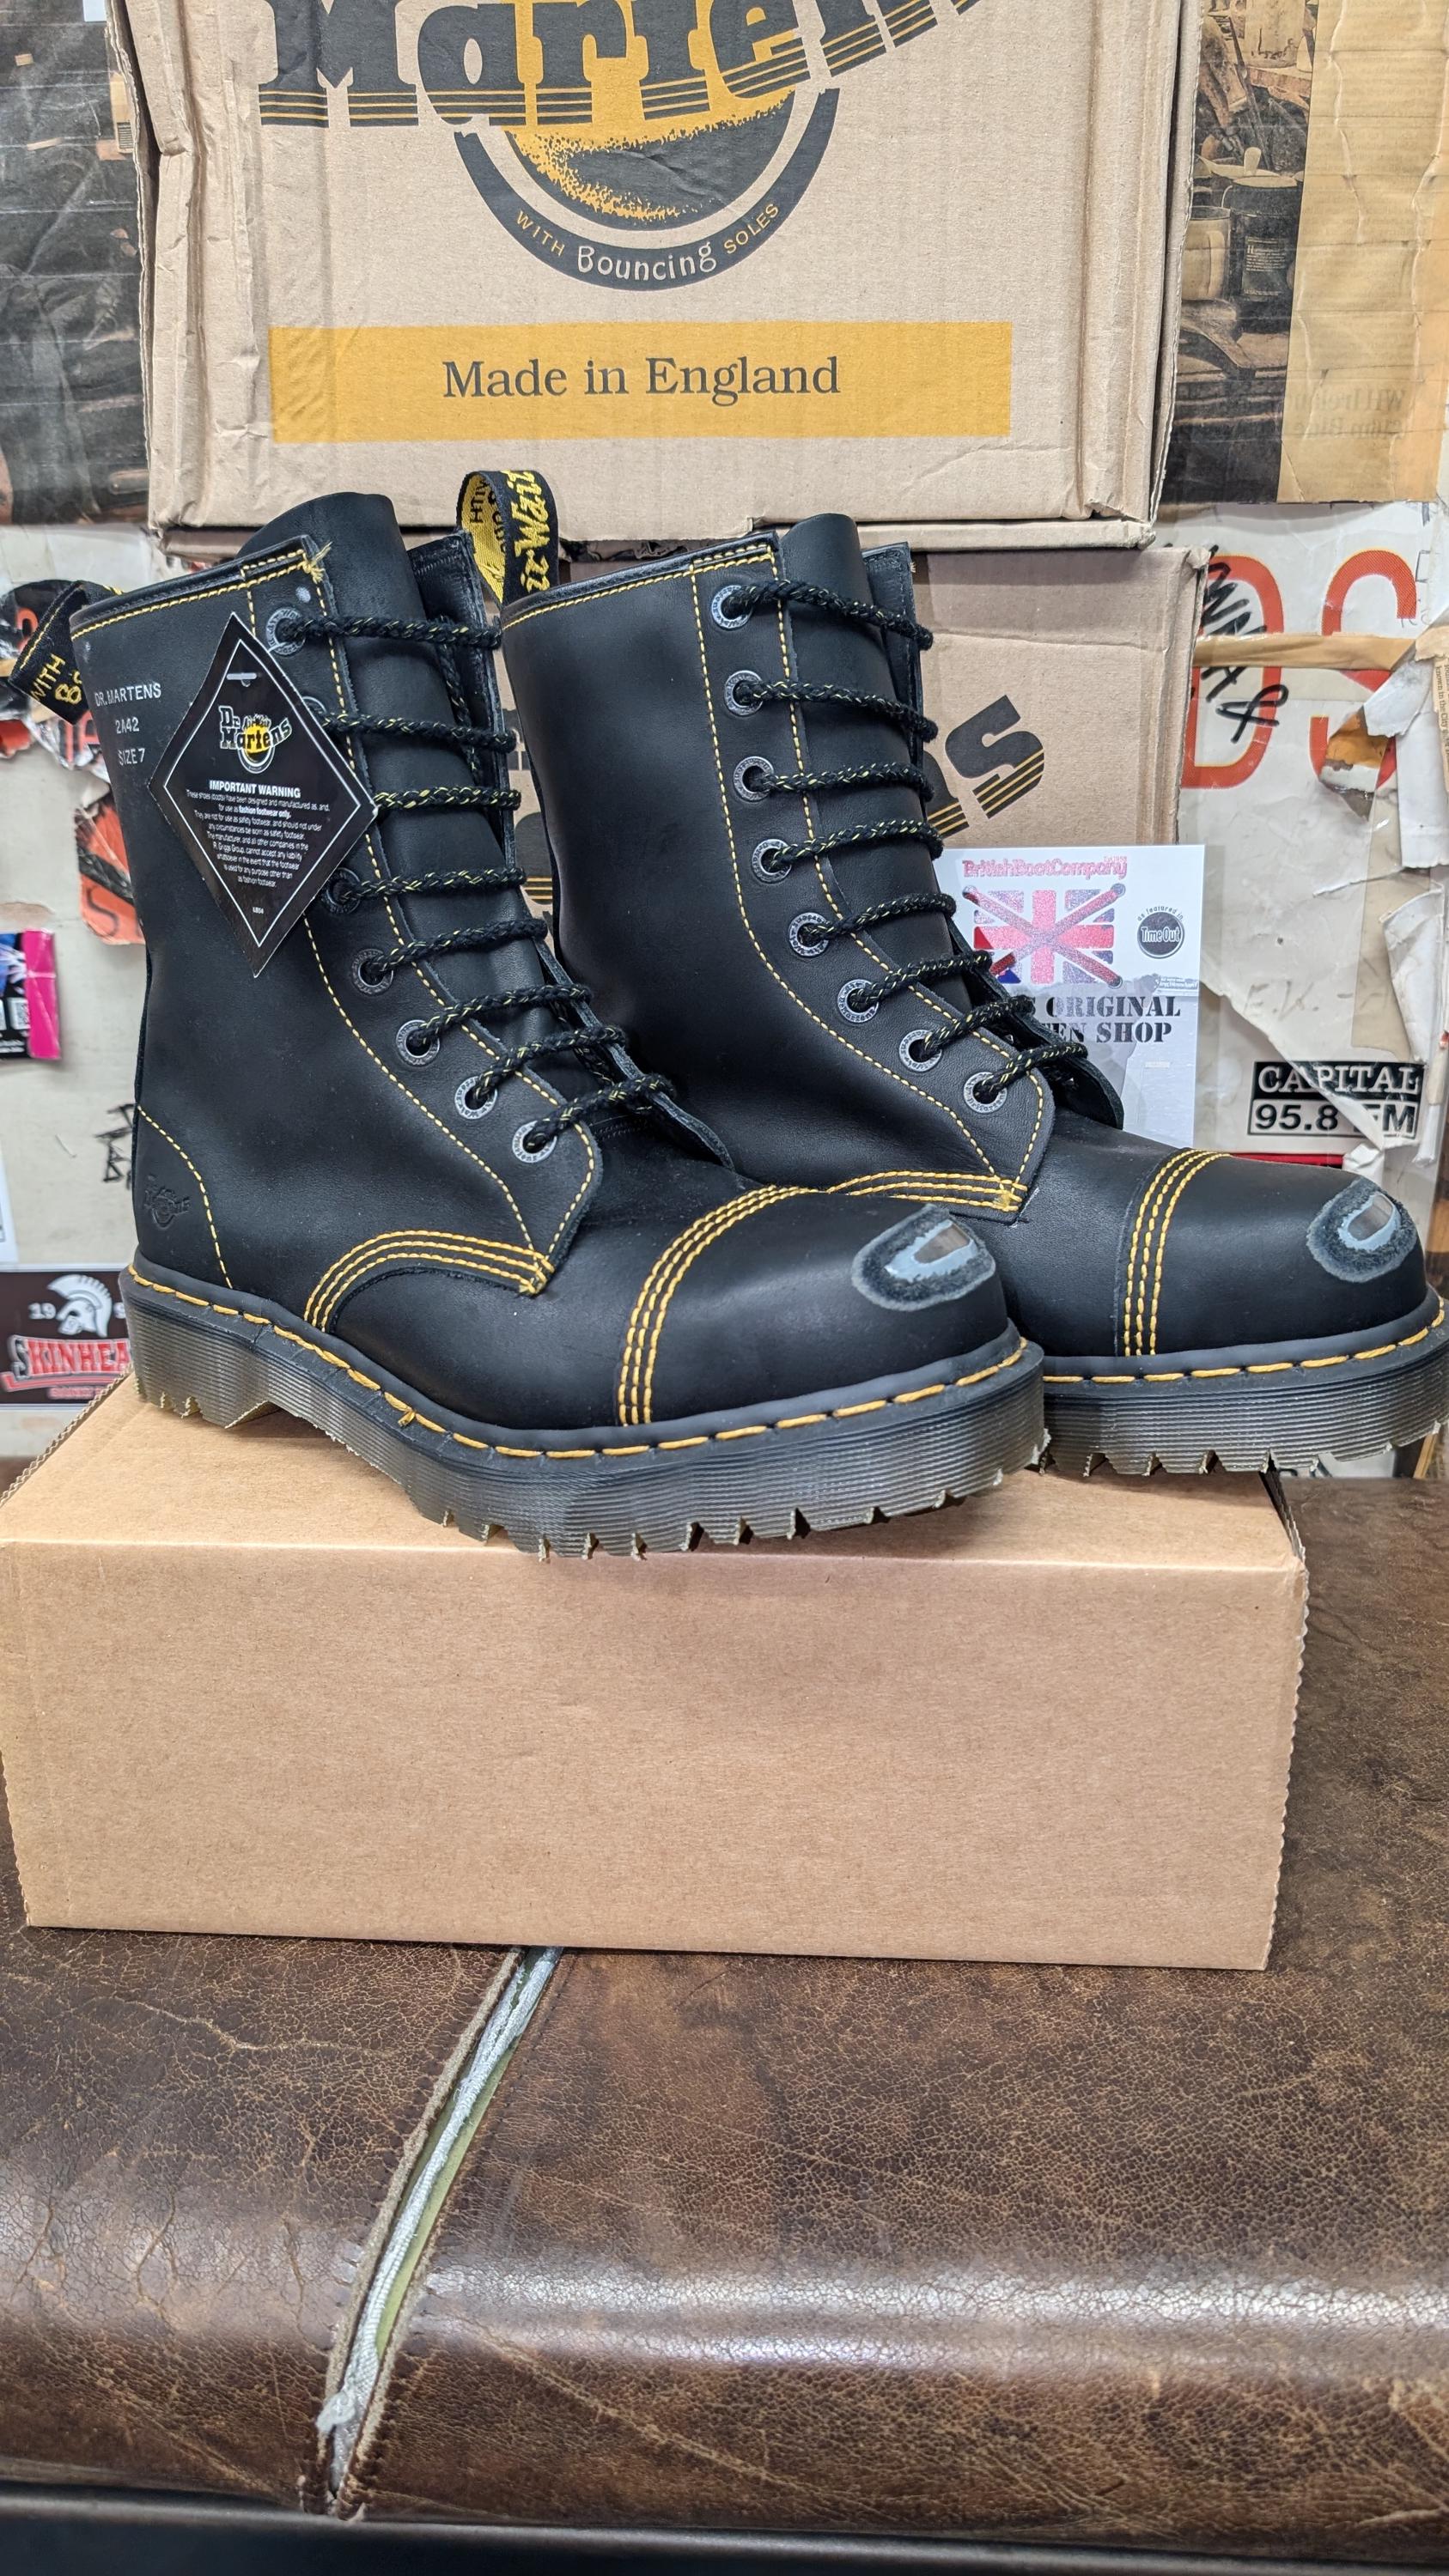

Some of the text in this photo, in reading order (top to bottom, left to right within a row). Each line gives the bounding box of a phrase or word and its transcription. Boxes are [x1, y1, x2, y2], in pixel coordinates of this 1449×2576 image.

[516, 203, 779, 281] WITH Bouncing SOLES
[442, 356, 841, 406] Made in England
[220, 718, 292, 750] Martens
[118, 748, 145, 766] SIZE 7
[209, 780, 301, 799] IMPORTANT WARNING
[238, 805, 256, 815] fashion
[256, 807, 277, 817] footwear
[1045, 996, 1181, 1018] ORIGINAL
[1096, 1022, 1172, 1043] SHOP
[1258, 1066, 1421, 1095] CAPITAL
[1255, 1104, 1338, 1131] 95.8
[7, 1334, 131, 1381] SKINHEA
